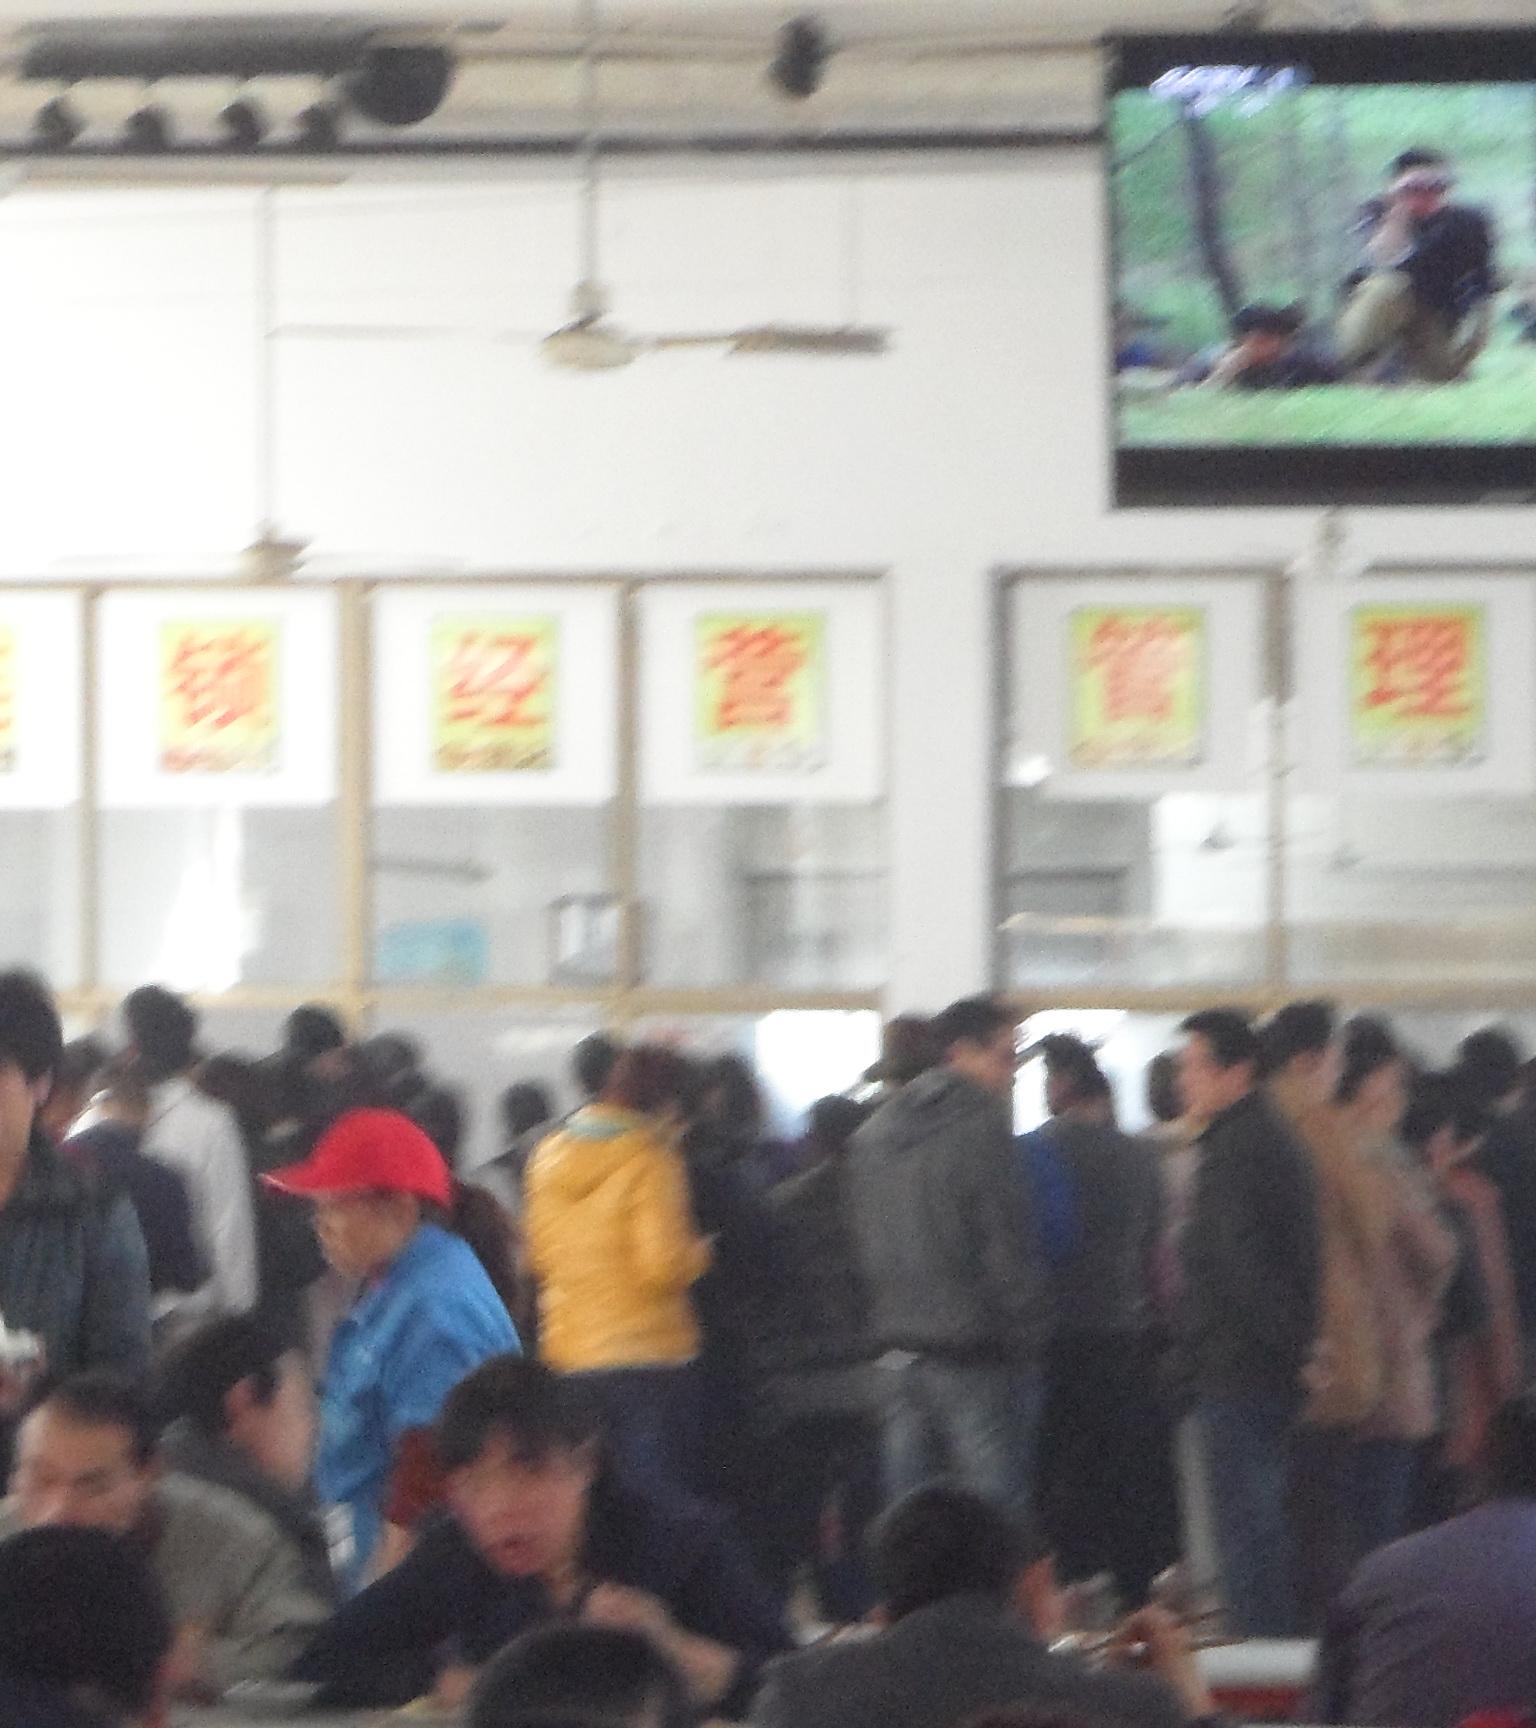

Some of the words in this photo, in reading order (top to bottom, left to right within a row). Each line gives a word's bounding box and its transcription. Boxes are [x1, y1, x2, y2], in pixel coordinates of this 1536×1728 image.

[446, 632, 548, 728] 经
[1084, 614, 1186, 718] 管
[1366, 615, 1472, 717] 理
